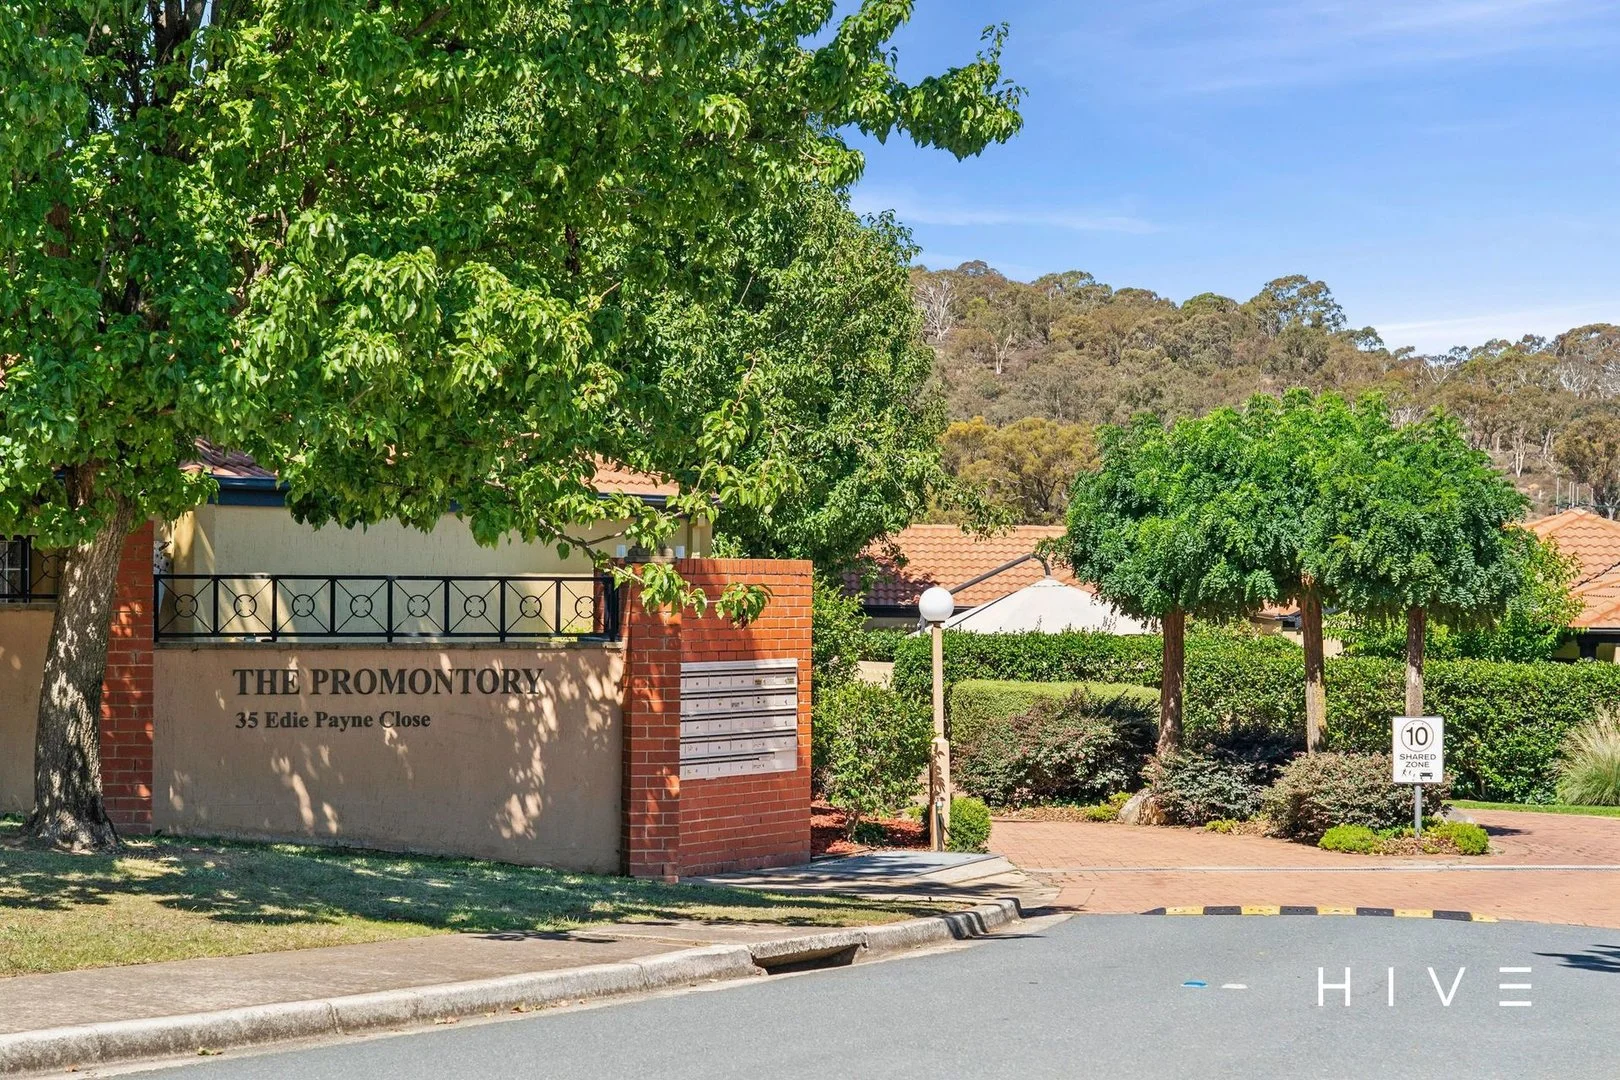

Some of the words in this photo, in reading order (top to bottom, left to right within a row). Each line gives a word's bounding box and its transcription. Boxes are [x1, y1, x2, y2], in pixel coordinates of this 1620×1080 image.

[232, 668, 300, 696] THE
[309, 667, 545, 696] PROMONTORY
[234, 712, 259, 729] 35
[264, 710, 309, 728] Edie
[314, 711, 373, 732] Payne
[379, 710, 431, 728] Close
[1406, 726, 1428, 746] 10
[1399, 753, 1437, 761] SHARED
